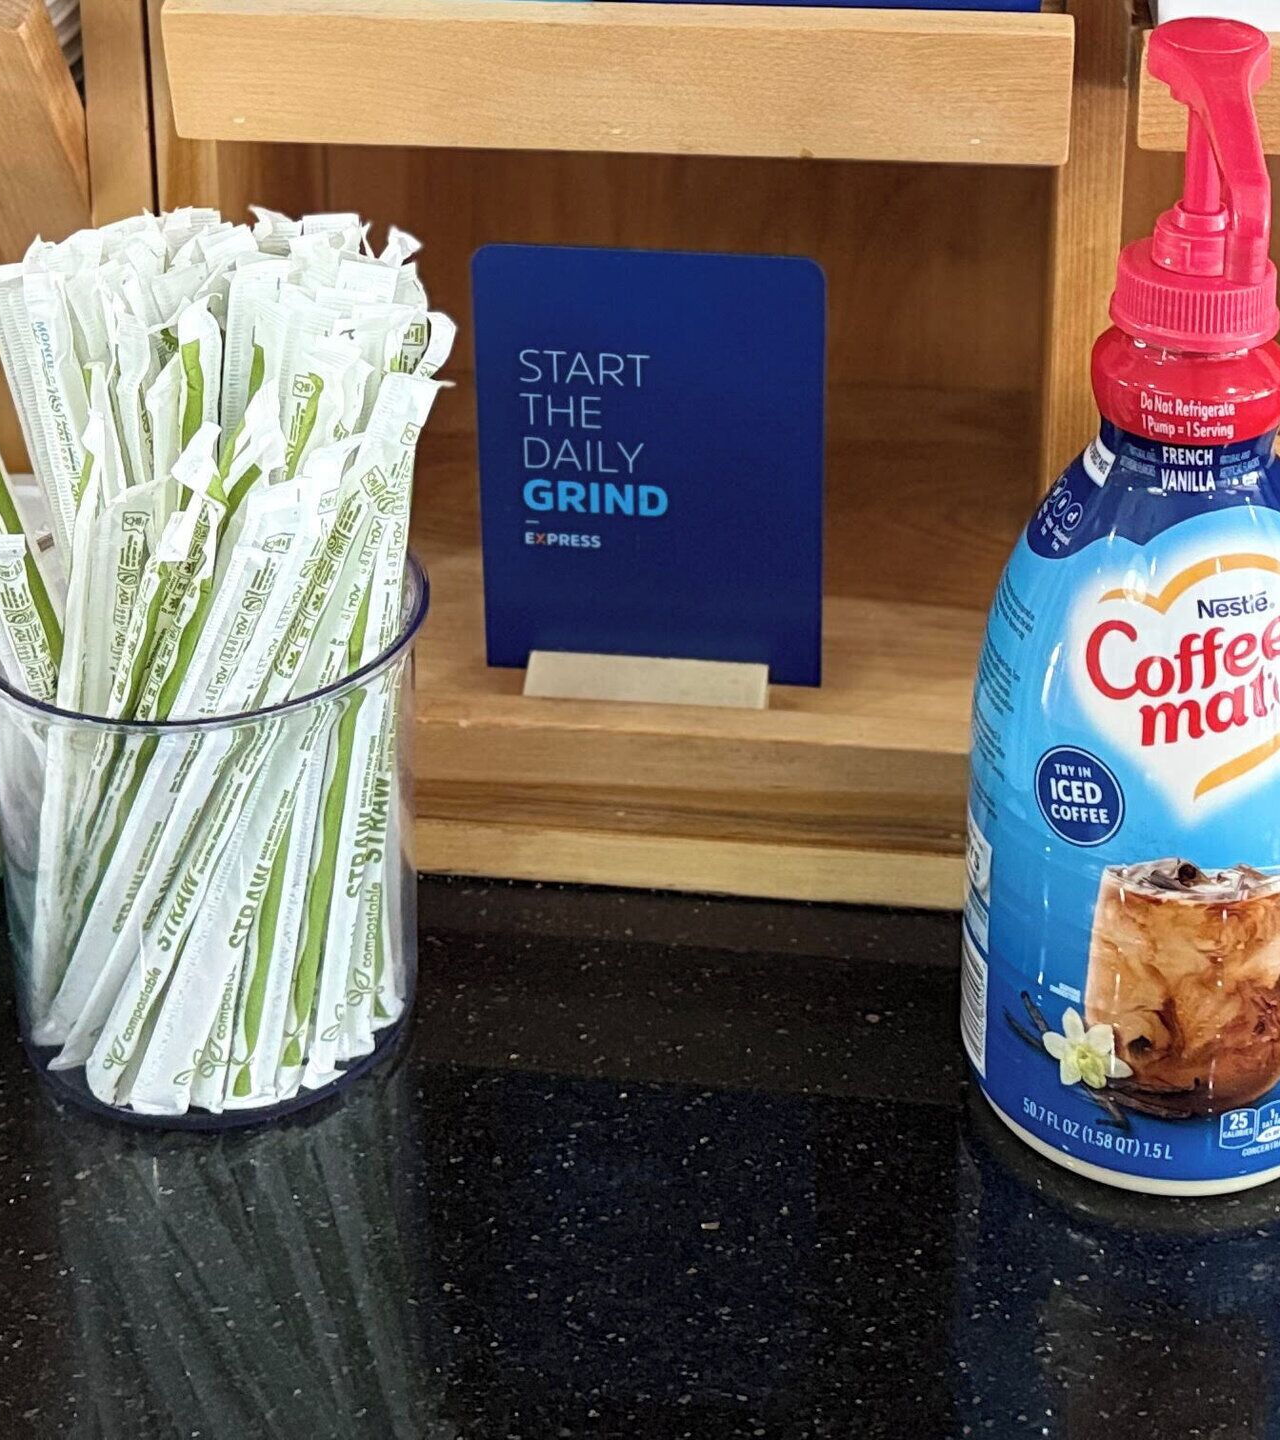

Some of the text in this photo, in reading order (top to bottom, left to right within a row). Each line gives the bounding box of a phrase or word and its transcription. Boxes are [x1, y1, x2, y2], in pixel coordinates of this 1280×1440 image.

[519, 348, 650, 388] START
[519, 392, 602, 430] THE
[1140, 391, 1235, 420] Do Not Refrigerate
[1148, 415, 1175, 438] Pump
[1193, 422, 1234, 438] Serving
[523, 436, 644, 475] DAILY
[1162, 446, 1213, 465] FRENCH
[1161, 468, 1216, 492] VANILLA
[522, 478, 668, 518] GRIND
[524, 531, 602, 549] EXPRESS
[1198, 591, 1270, 619] Nestlé
[1054, 763, 1092, 778] TRY IN
[1050, 779, 1103, 805] ICED
[370, 772, 391, 864] STRAW
[1050, 804, 1110, 826] COFFEE
[157, 868, 199, 952] STRAW
[229, 861, 271, 949] STRAW
[364, 882, 381, 969] compostable
[122, 968, 162, 1043] compostable
[1022, 1095, 1173, 1159] 50.7 FL OZ (1.58 QT) 1.5 L
[1228, 1112, 1249, 1130] 25
